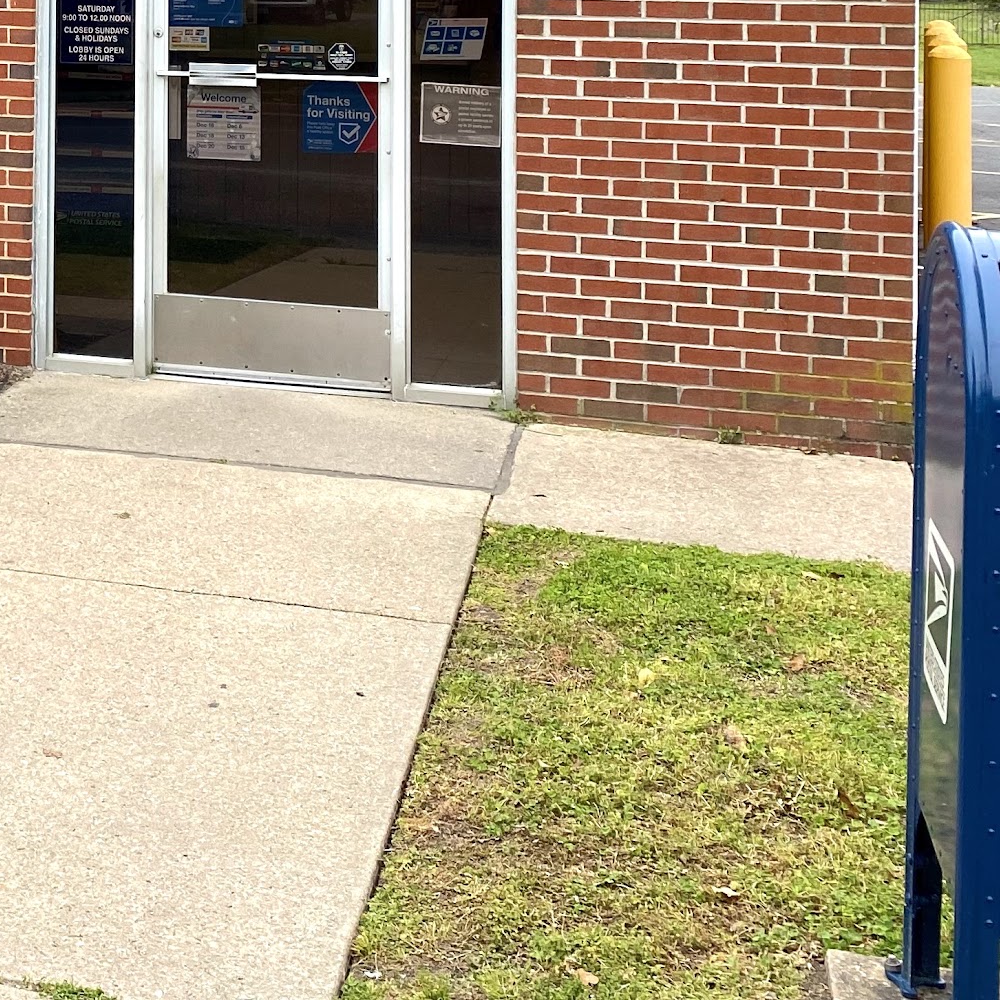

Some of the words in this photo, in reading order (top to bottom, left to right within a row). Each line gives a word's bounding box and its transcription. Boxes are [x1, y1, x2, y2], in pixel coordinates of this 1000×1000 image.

[77, 5, 116, 13] SATURDAY
[63, 26, 94, 34] CLOSED
[94, 26, 129, 35] SUNDAYS
[81, 35, 118, 43] HOLIDAYS
[68, 46, 94, 54] LOBBY
[94, 46, 102, 54] IS
[103, 46, 125, 55] OPEN
[78, 54, 87, 62] 24
[88, 54, 115, 63] HOURS
[434, 85, 490, 96] WARNING
[200, 93, 247, 104] Welcome
[307, 95, 351, 107] Thanks
[307, 107, 324, 118] for
[326, 108, 371, 122] Visiting
